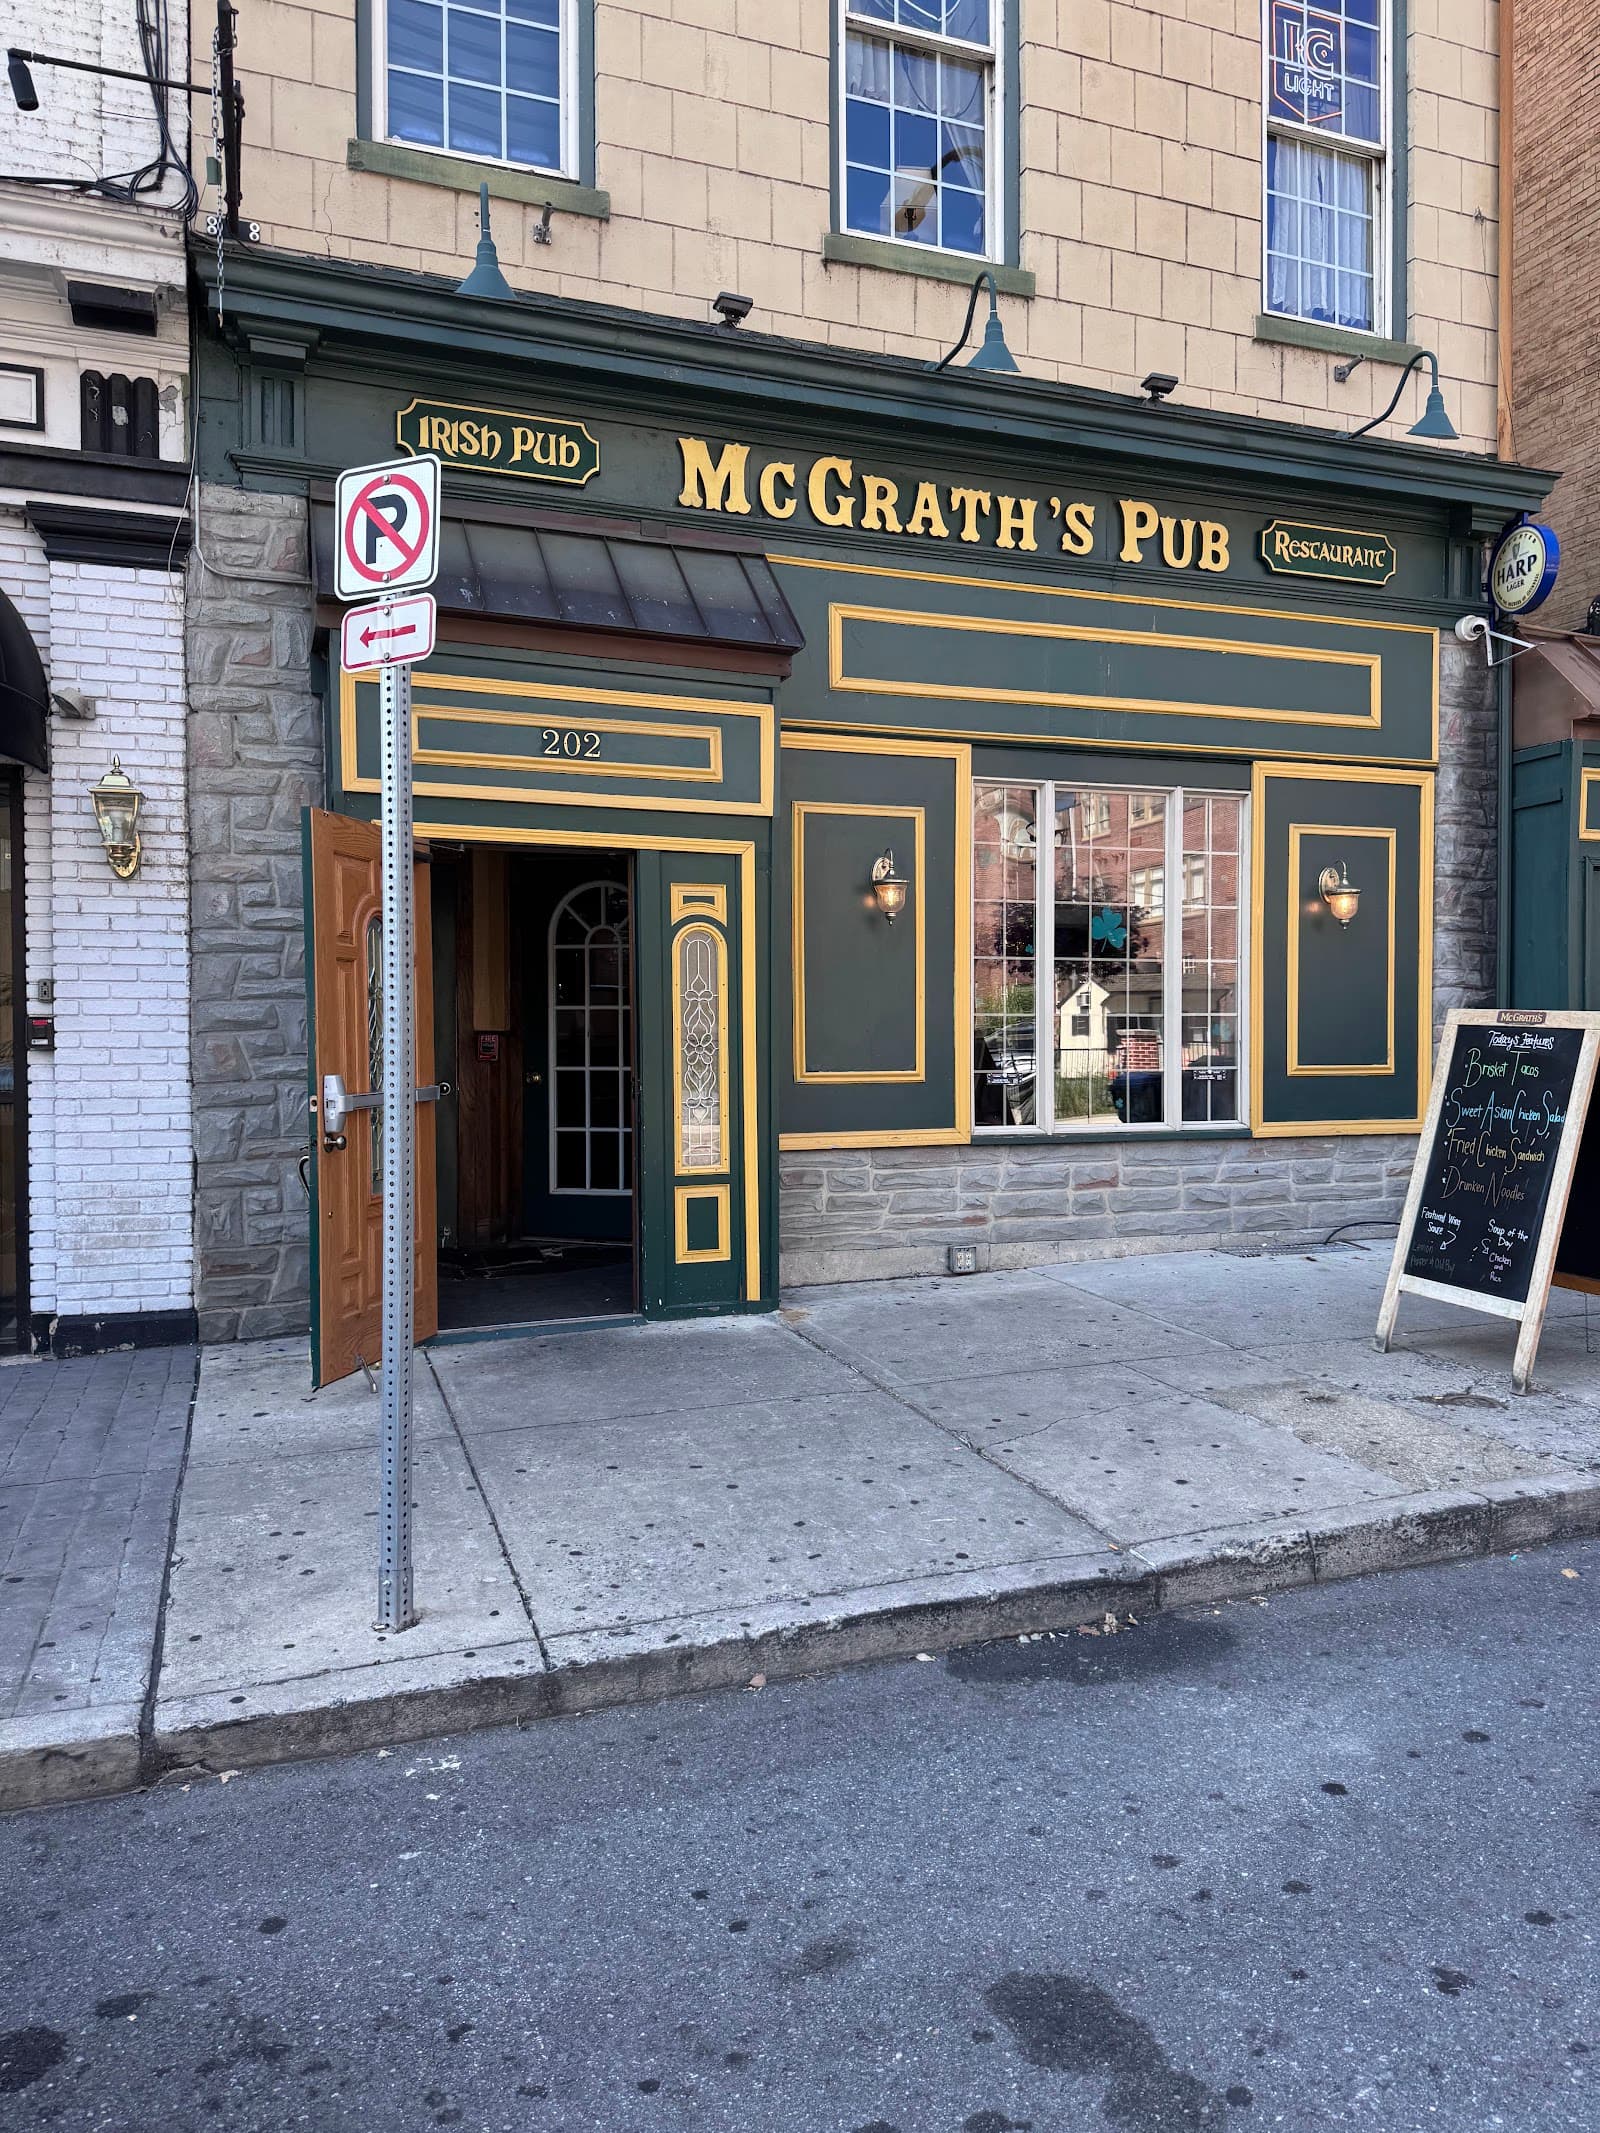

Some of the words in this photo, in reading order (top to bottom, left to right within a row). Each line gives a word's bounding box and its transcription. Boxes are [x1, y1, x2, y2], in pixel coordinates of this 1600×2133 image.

[1284, 73, 1334, 101] LIGHT
[1118, 498, 1231, 573] PUB
[1497, 554, 1537, 586] HARP
[1506, 579, 1525, 592] LAGER
[542, 729, 601, 758] 202
[1463, 1047, 1509, 1088] Brisket
[1510, 1050, 1540, 1086] Tacos
[1445, 1087, 1484, 1128] Sweet
[1480, 1090, 1513, 1132] Asian
[1510, 1089, 1541, 1134] Chicken
[1536, 1090, 1567, 1136] Salad
[1447, 1127, 1477, 1161] Fried
[1476, 1130, 1507, 1168] Chicken
[1505, 1137, 1545, 1173] Sandwich
[1440, 1165, 1485, 1199] Drunken
[1484, 1172, 1525, 1208] Noodles
[1487, 1218, 1506, 1236] Soup
[1507, 1229, 1516, 1238] of
[1516, 1228, 1529, 1243] the
[1497, 1236, 1513, 1252] Day
